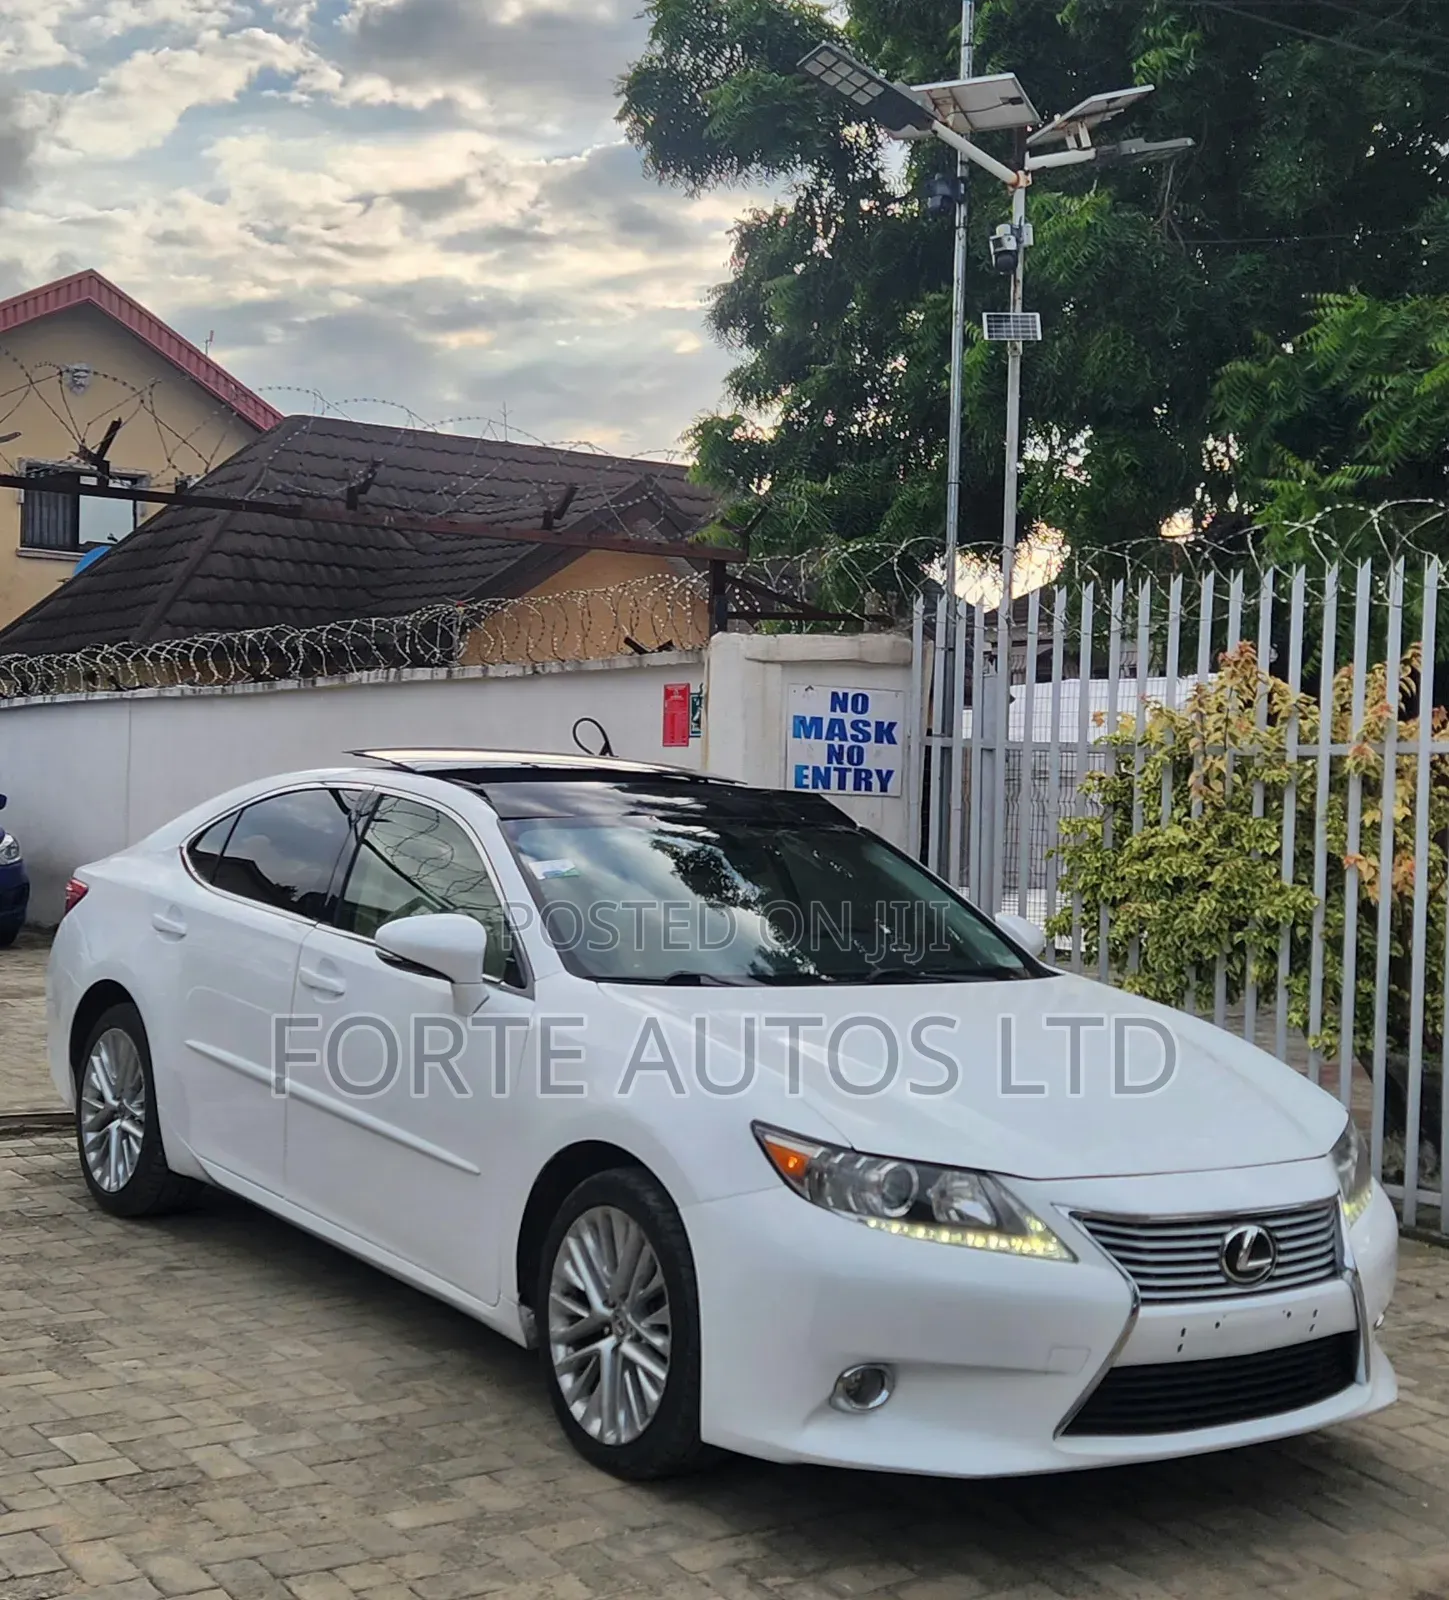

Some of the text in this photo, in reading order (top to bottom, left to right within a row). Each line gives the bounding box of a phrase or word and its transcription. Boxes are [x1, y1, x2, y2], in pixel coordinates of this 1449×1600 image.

[830, 691, 869, 714] NO
[793, 715, 897, 744] MASK
[828, 745, 865, 766] NO
[794, 765, 895, 793] ENTRY
